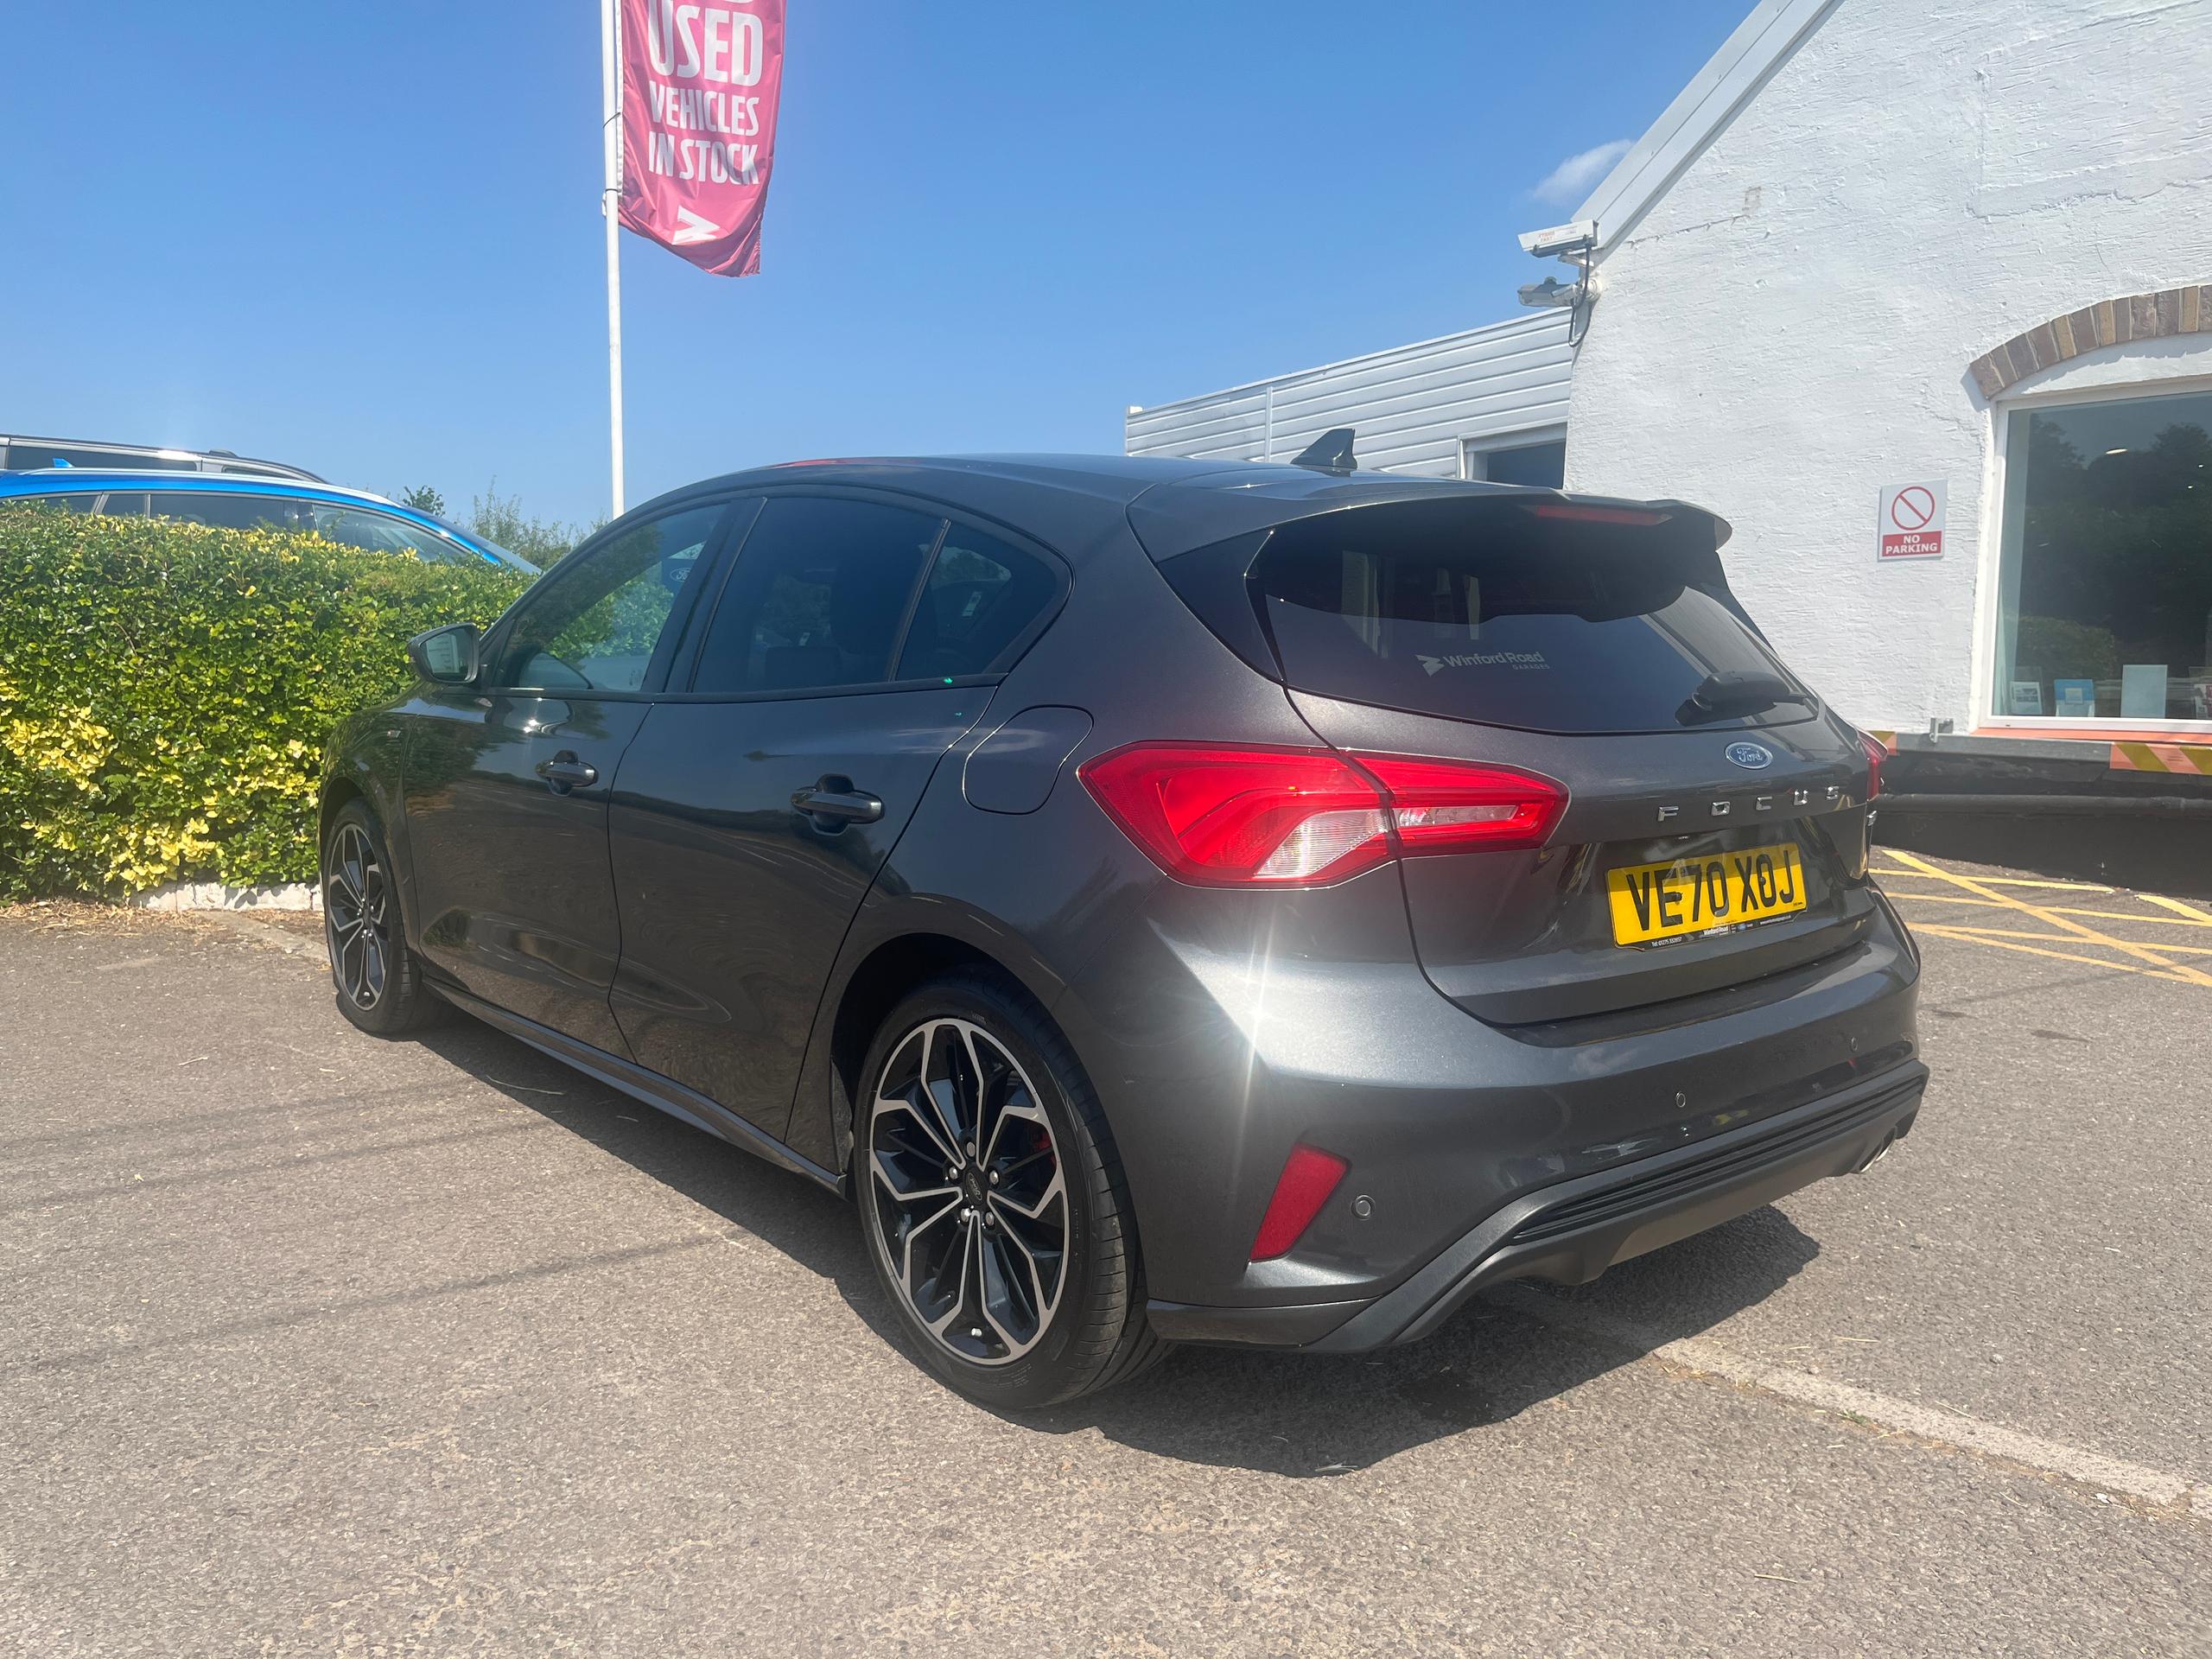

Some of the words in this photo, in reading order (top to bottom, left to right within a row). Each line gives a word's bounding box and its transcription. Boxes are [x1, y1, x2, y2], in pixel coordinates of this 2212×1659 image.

[649, 0, 763, 86] USED
[649, 80, 760, 137] VEHICLES
[649, 131, 675, 177] IN
[679, 138, 760, 185] STOCK
[1885, 543, 1937, 554] PARKING
[1903, 535, 1920, 544] NO
[1444, 652, 1505, 668] Winford
[1505, 652, 1545, 664] Road
[1737, 747, 1764, 762] Ford
[1657, 785, 1840, 822] FOCUS
[1626, 861, 1730, 931] VE70
[1735, 849, 1796, 913] XOJ
